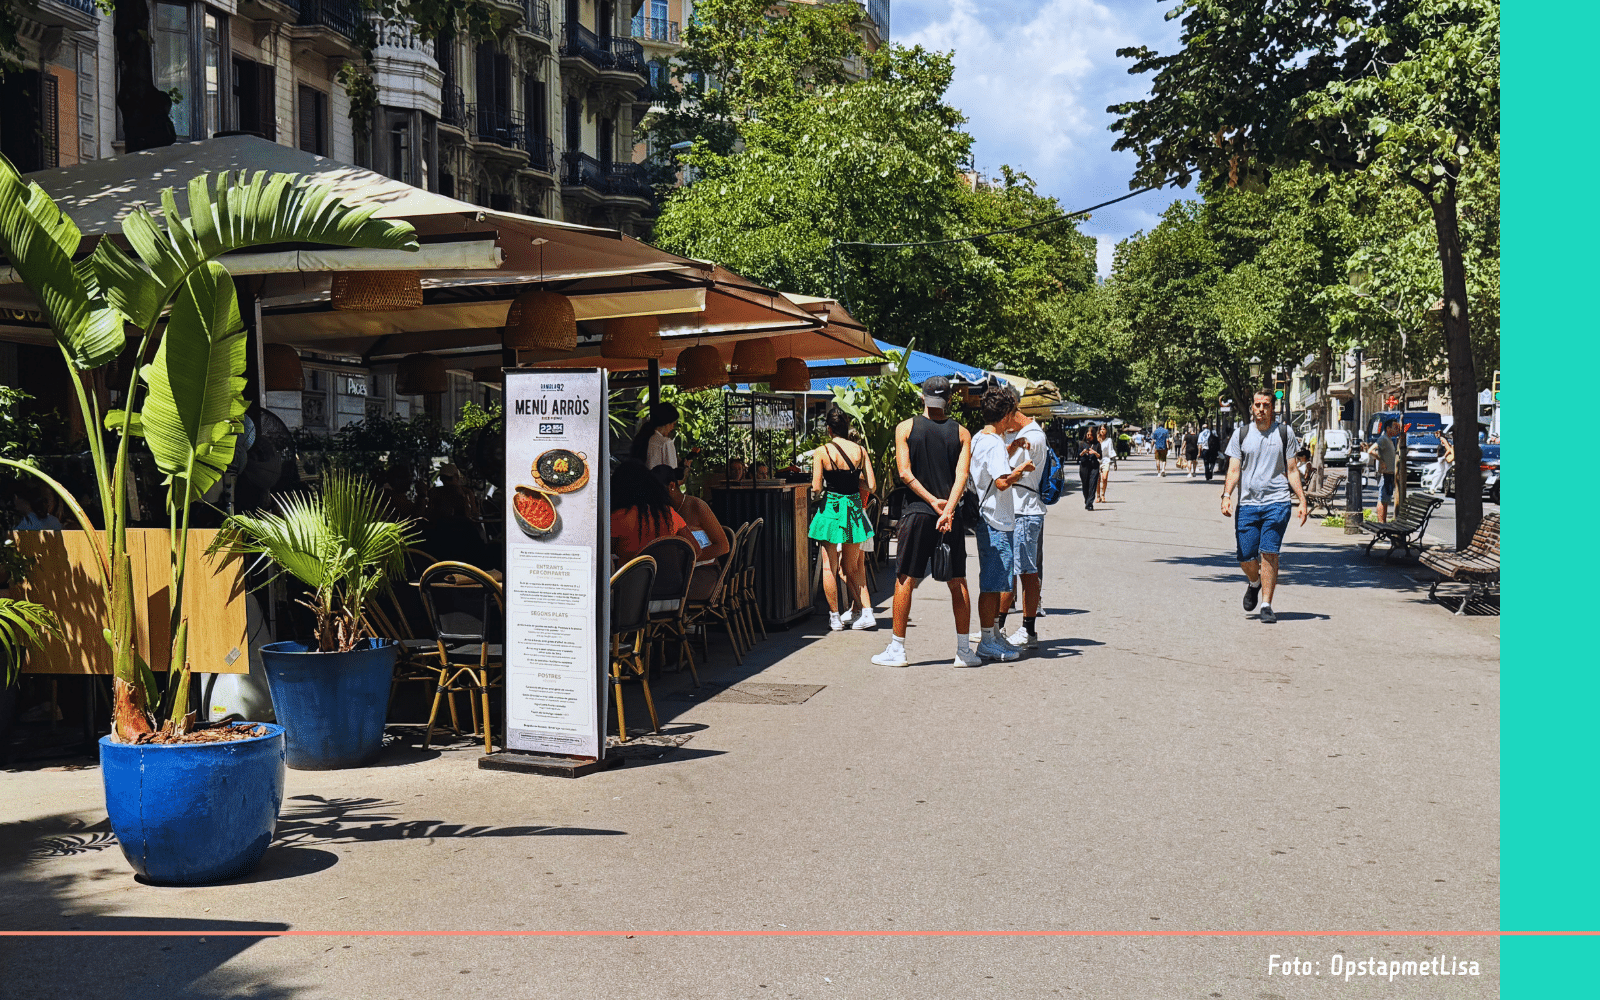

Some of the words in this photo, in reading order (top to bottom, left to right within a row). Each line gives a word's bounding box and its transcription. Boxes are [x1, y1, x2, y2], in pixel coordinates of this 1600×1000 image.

[515, 394, 547, 415] MENÚ
[552, 394, 589, 415] ARRÒS
[540, 424, 552, 433] 22
